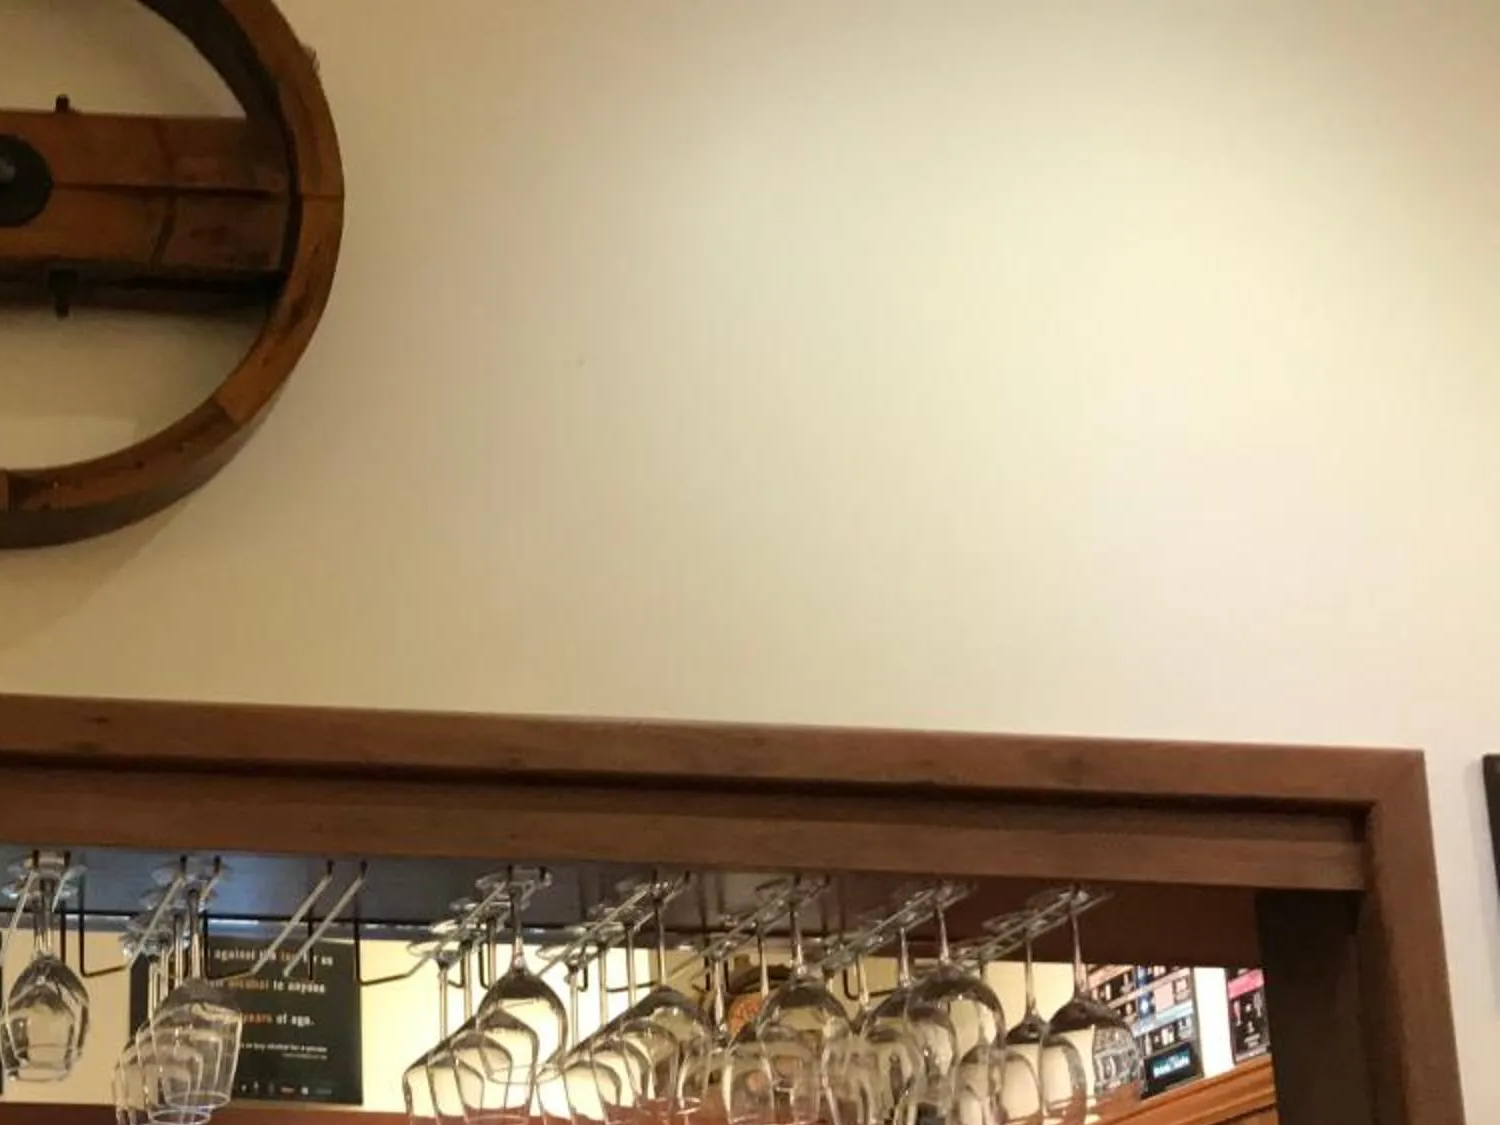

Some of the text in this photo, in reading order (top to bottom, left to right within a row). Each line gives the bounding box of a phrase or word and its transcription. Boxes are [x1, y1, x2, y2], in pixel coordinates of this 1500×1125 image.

[273, 980, 285, 992] to
[287, 982, 326, 995] anyone
[276, 1013, 288, 1024] of
